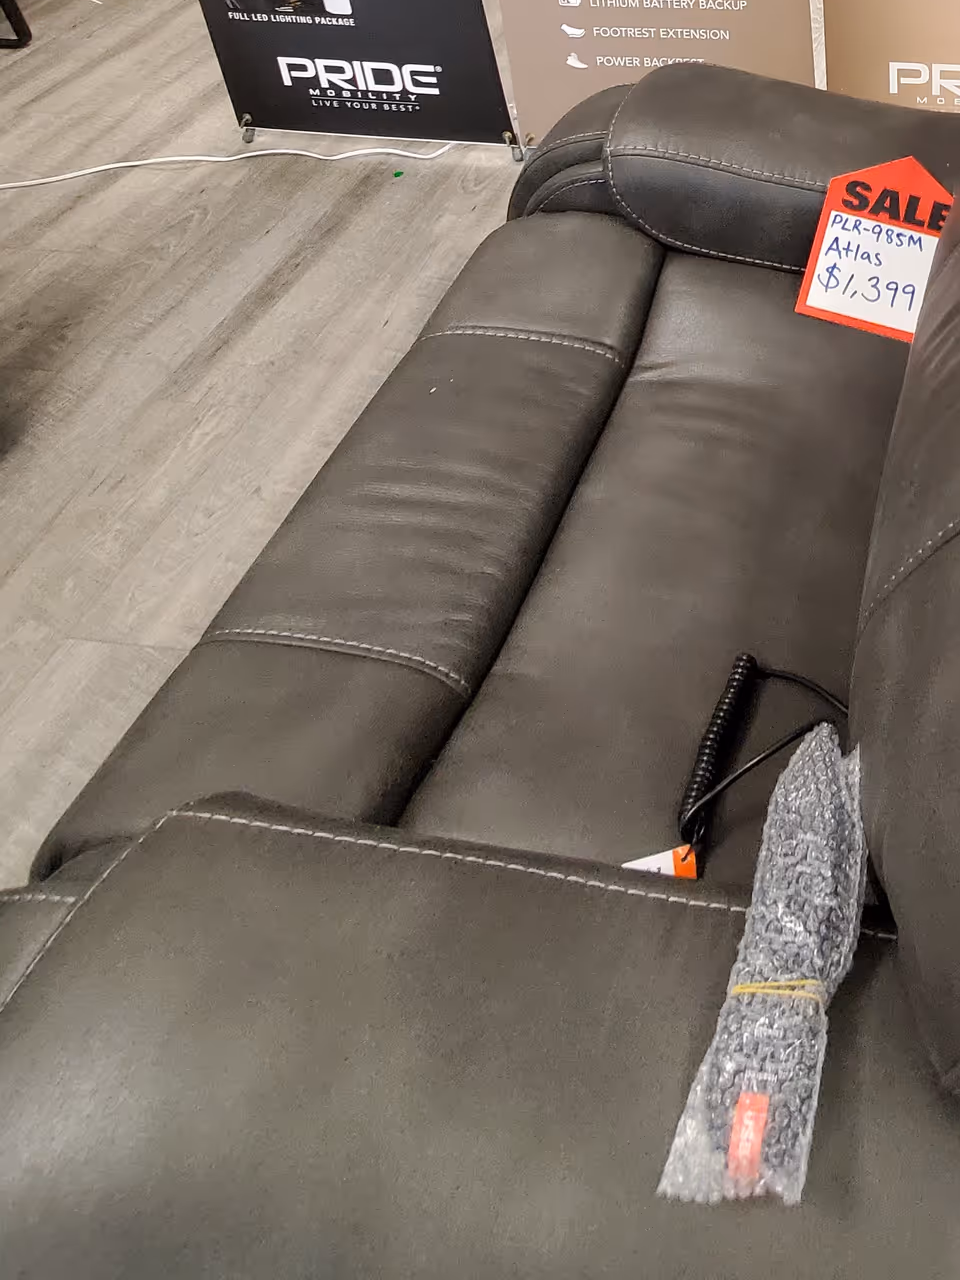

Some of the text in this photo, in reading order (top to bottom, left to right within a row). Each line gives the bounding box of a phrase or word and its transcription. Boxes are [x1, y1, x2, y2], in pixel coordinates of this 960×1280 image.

[699, 0, 747, 11] BACKUP
[228, 12, 355, 27] FULL LED LIGHTING PACKAGE
[593, 27, 730, 40] FOOTREST EXTENSION
[596, 56, 640, 67] POWER
[277, 57, 440, 95] PRIDE
[308, 89, 418, 101] MOBILITY
[312, 100, 416, 112] LIVE YOUR BEST
[842, 180, 952, 232] SALE
[831, 214, 923, 252] PLR-985M
[825, 236, 883, 267] Atlas
[818, 262, 916, 312] $1,399
